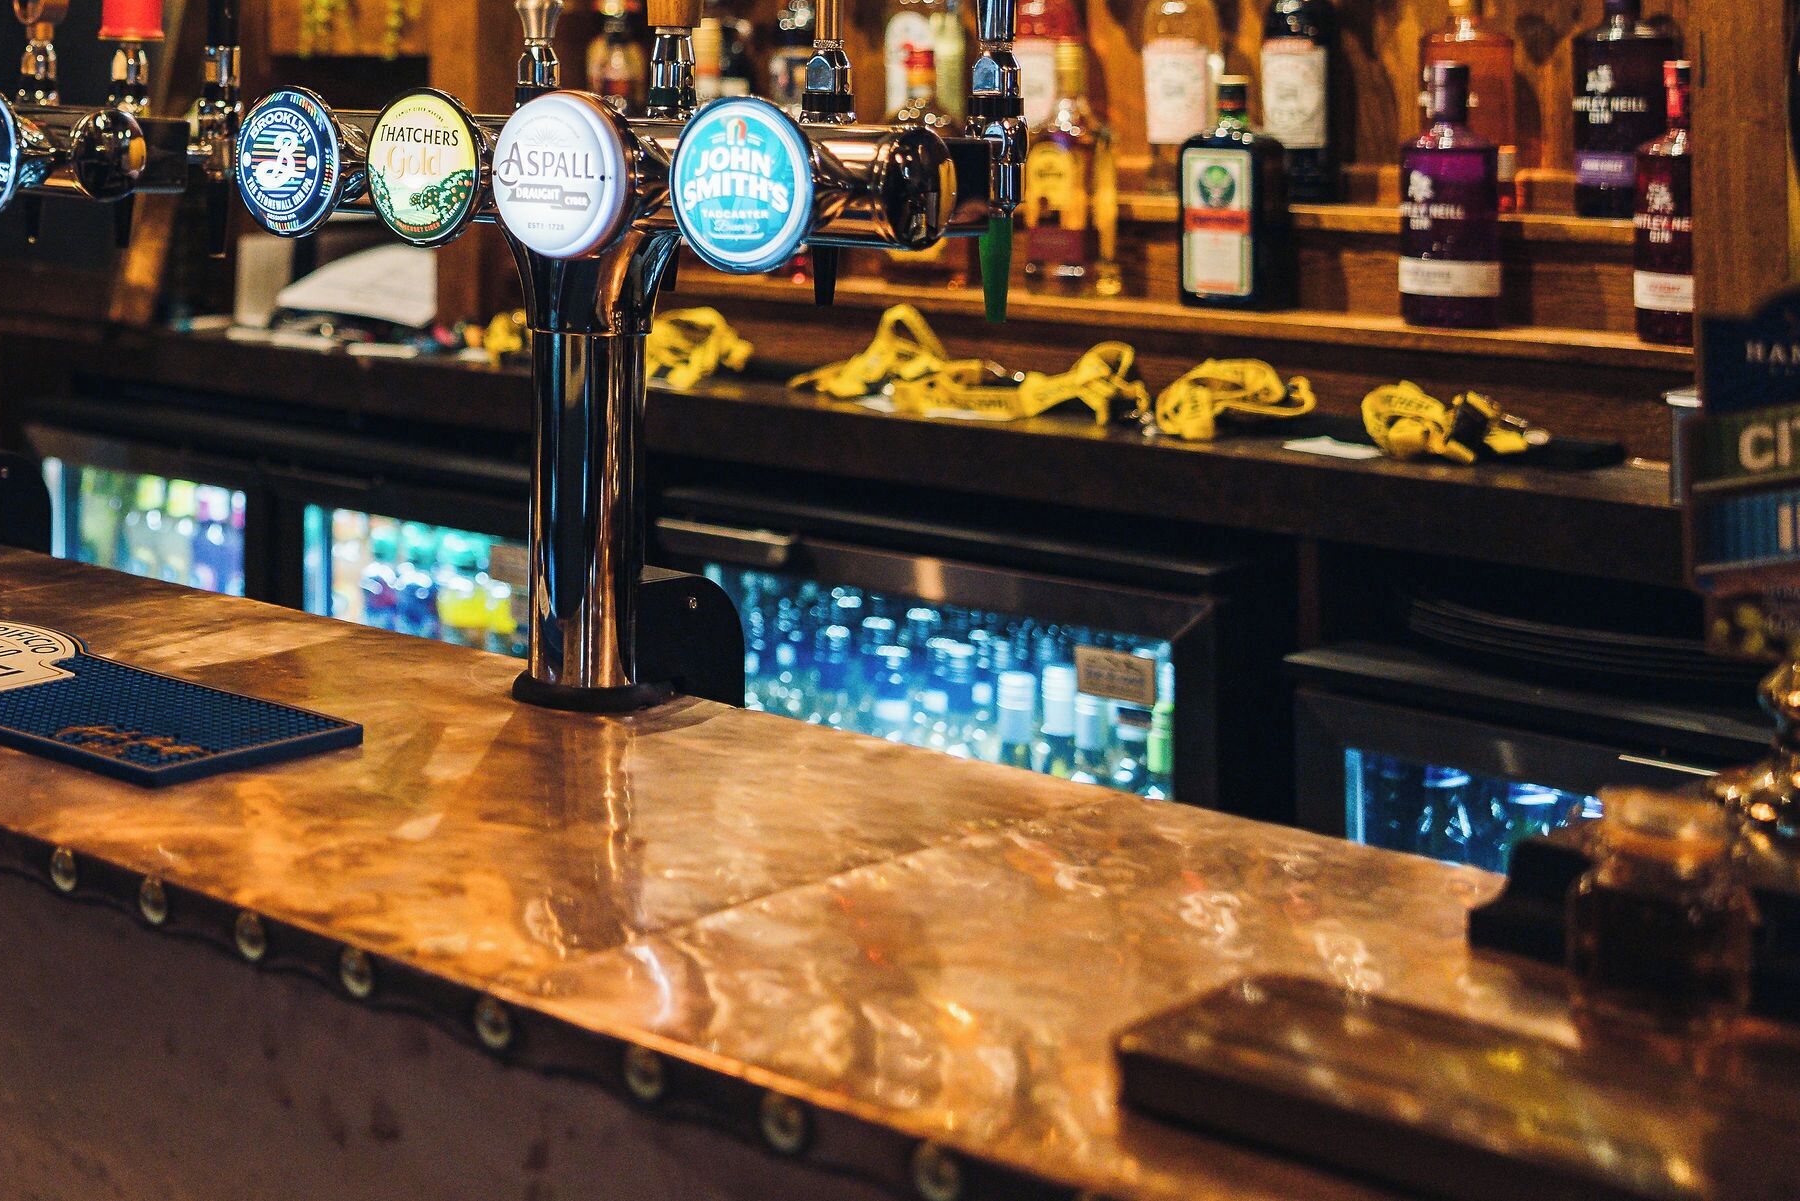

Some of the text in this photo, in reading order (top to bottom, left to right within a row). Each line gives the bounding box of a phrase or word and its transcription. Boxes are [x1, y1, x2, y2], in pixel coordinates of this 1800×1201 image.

[249, 111, 312, 143] BROOKLYN
[380, 124, 459, 146] THATCHERS
[387, 145, 442, 180] Gold
[498, 141, 594, 186] ASPALL
[695, 146, 772, 178] JOHN
[515, 186, 561, 201] DRAUGHT
[683, 170, 789, 213] SMITH'S
[1738, 416, 1800, 471] CI
